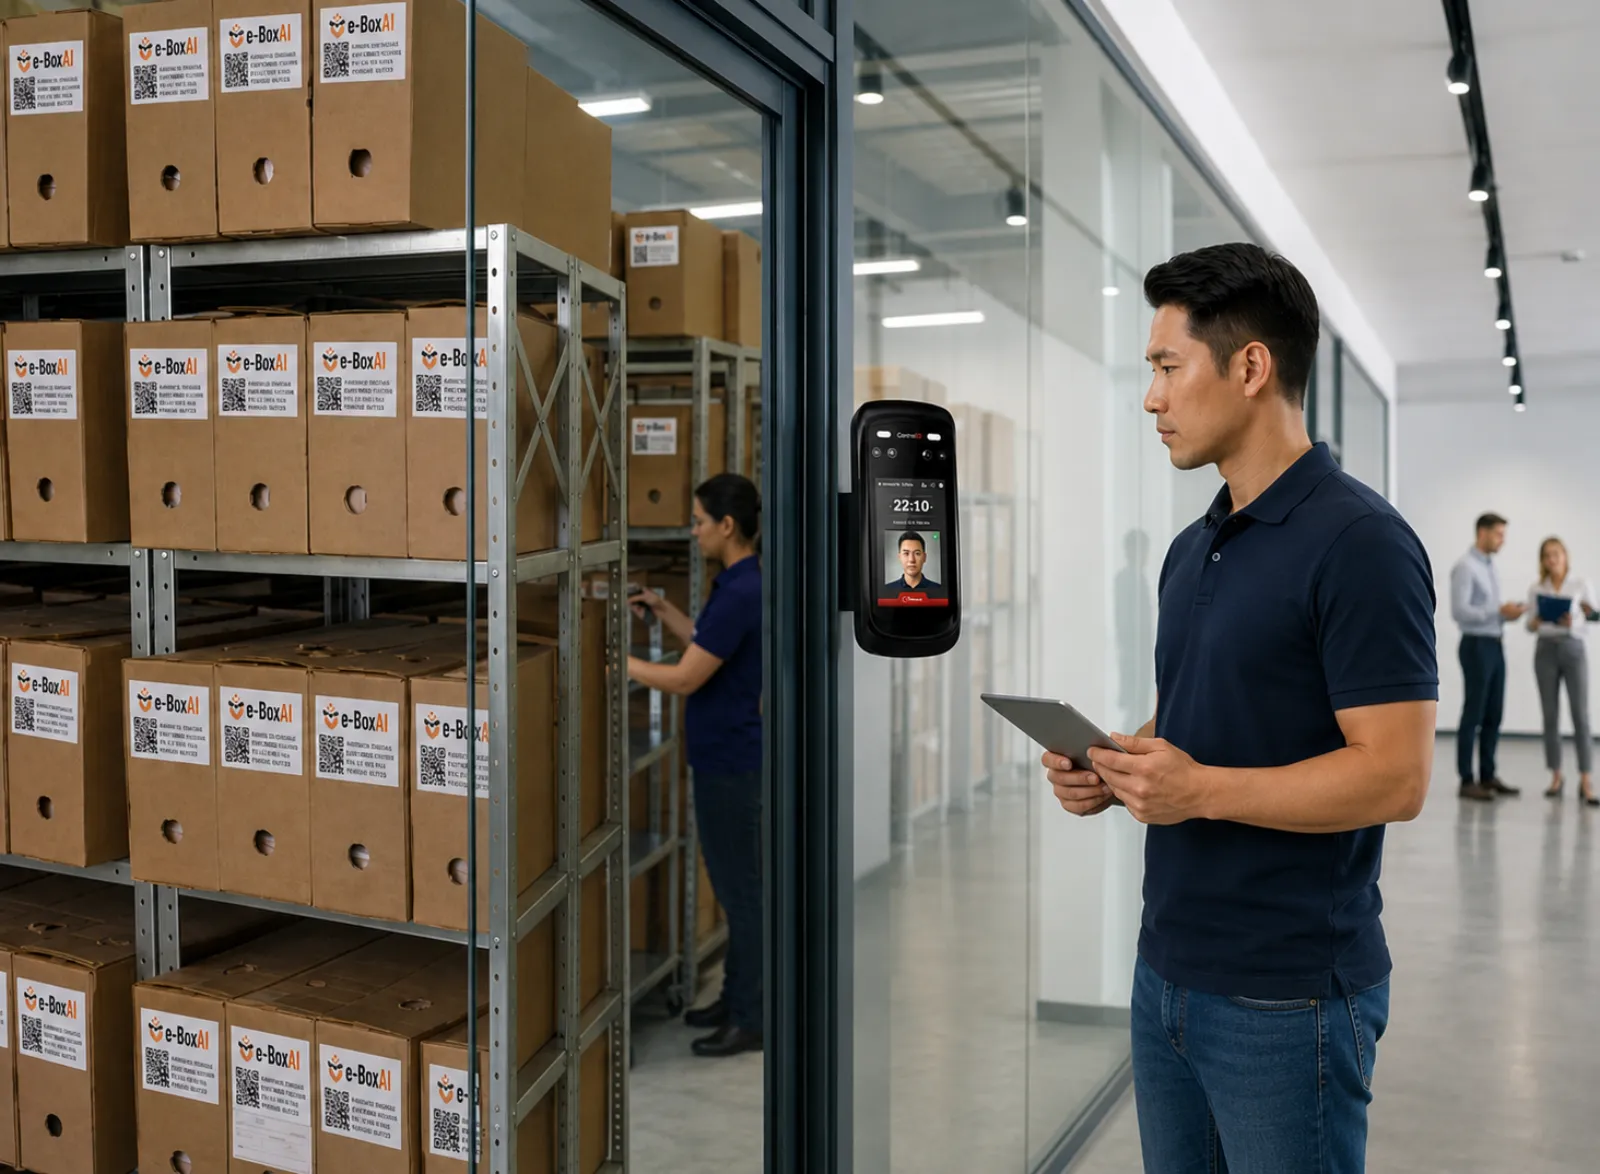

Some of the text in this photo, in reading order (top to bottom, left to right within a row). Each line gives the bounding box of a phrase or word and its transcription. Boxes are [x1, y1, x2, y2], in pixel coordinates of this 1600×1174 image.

[246, 23, 291, 44] e-BoxAI
[347, 13, 395, 34] e-BoxAI
[155, 36, 198, 56] e-BoxAI
[33, 49, 74, 69] e-BoxAI
[29, 357, 68, 376] e-BoxAI
[154, 357, 197, 375] e-BoxAI
[243, 353, 288, 372] e-BoxAI
[340, 351, 386, 370] e-BoxAI
[440, 347, 487, 367] e-BoxA
[893, 499, 930, 512] 22:10
[32, 676, 70, 697] e-BoxAI
[154, 693, 199, 715] e-BoxAI
[246, 701, 293, 723] e-BoxAI
[341, 710, 389, 733] e-BoxAI
[443, 719, 489, 743] e-BoxA
[38, 995, 77, 1020] e-BoxAI
[165, 1025, 209, 1050] e-BoxAI
[256, 1044, 300, 1070] e-BoxAI
[345, 1064, 391, 1091] e-BoxAI
